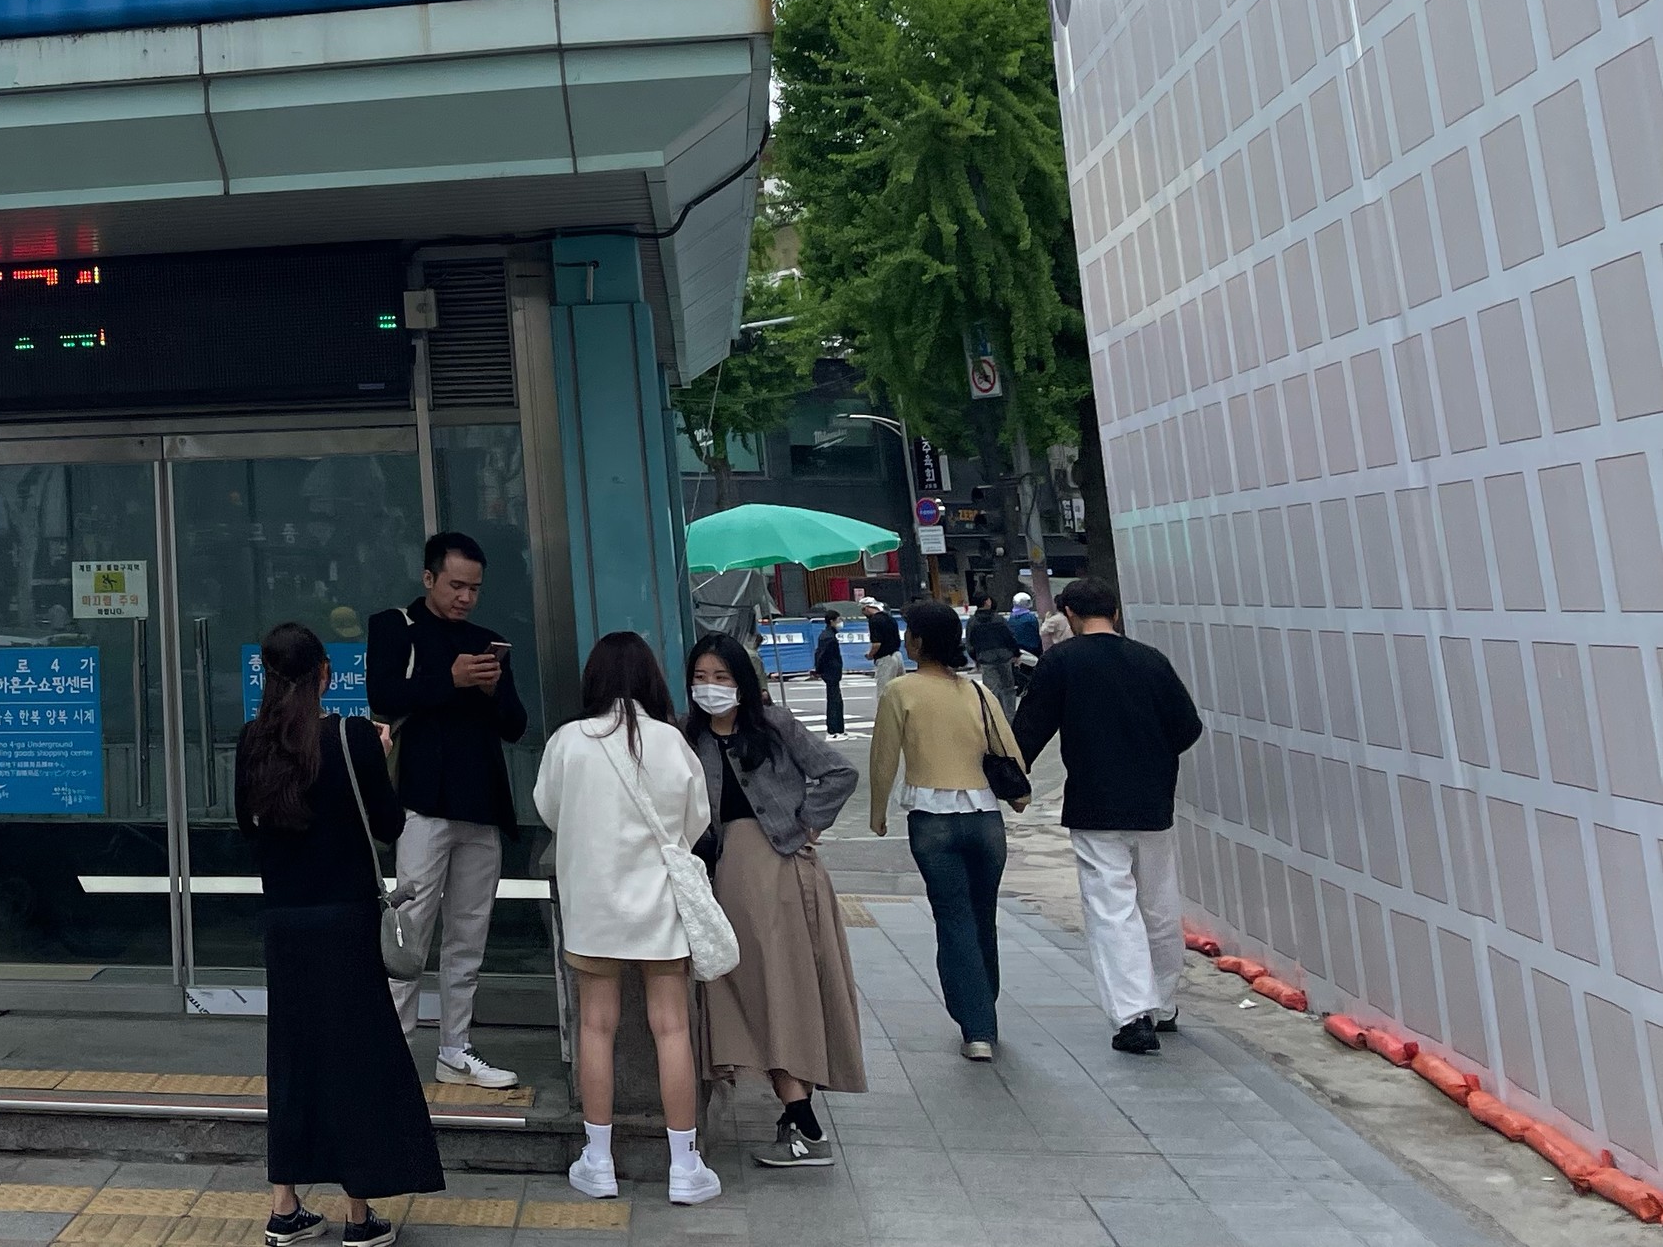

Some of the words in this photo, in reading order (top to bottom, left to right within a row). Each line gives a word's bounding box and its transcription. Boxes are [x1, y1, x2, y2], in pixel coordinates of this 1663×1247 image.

[19, 709, 41, 726] 한복
[46, 709, 68, 726] 양복
[73, 709, 94, 725] 시계
